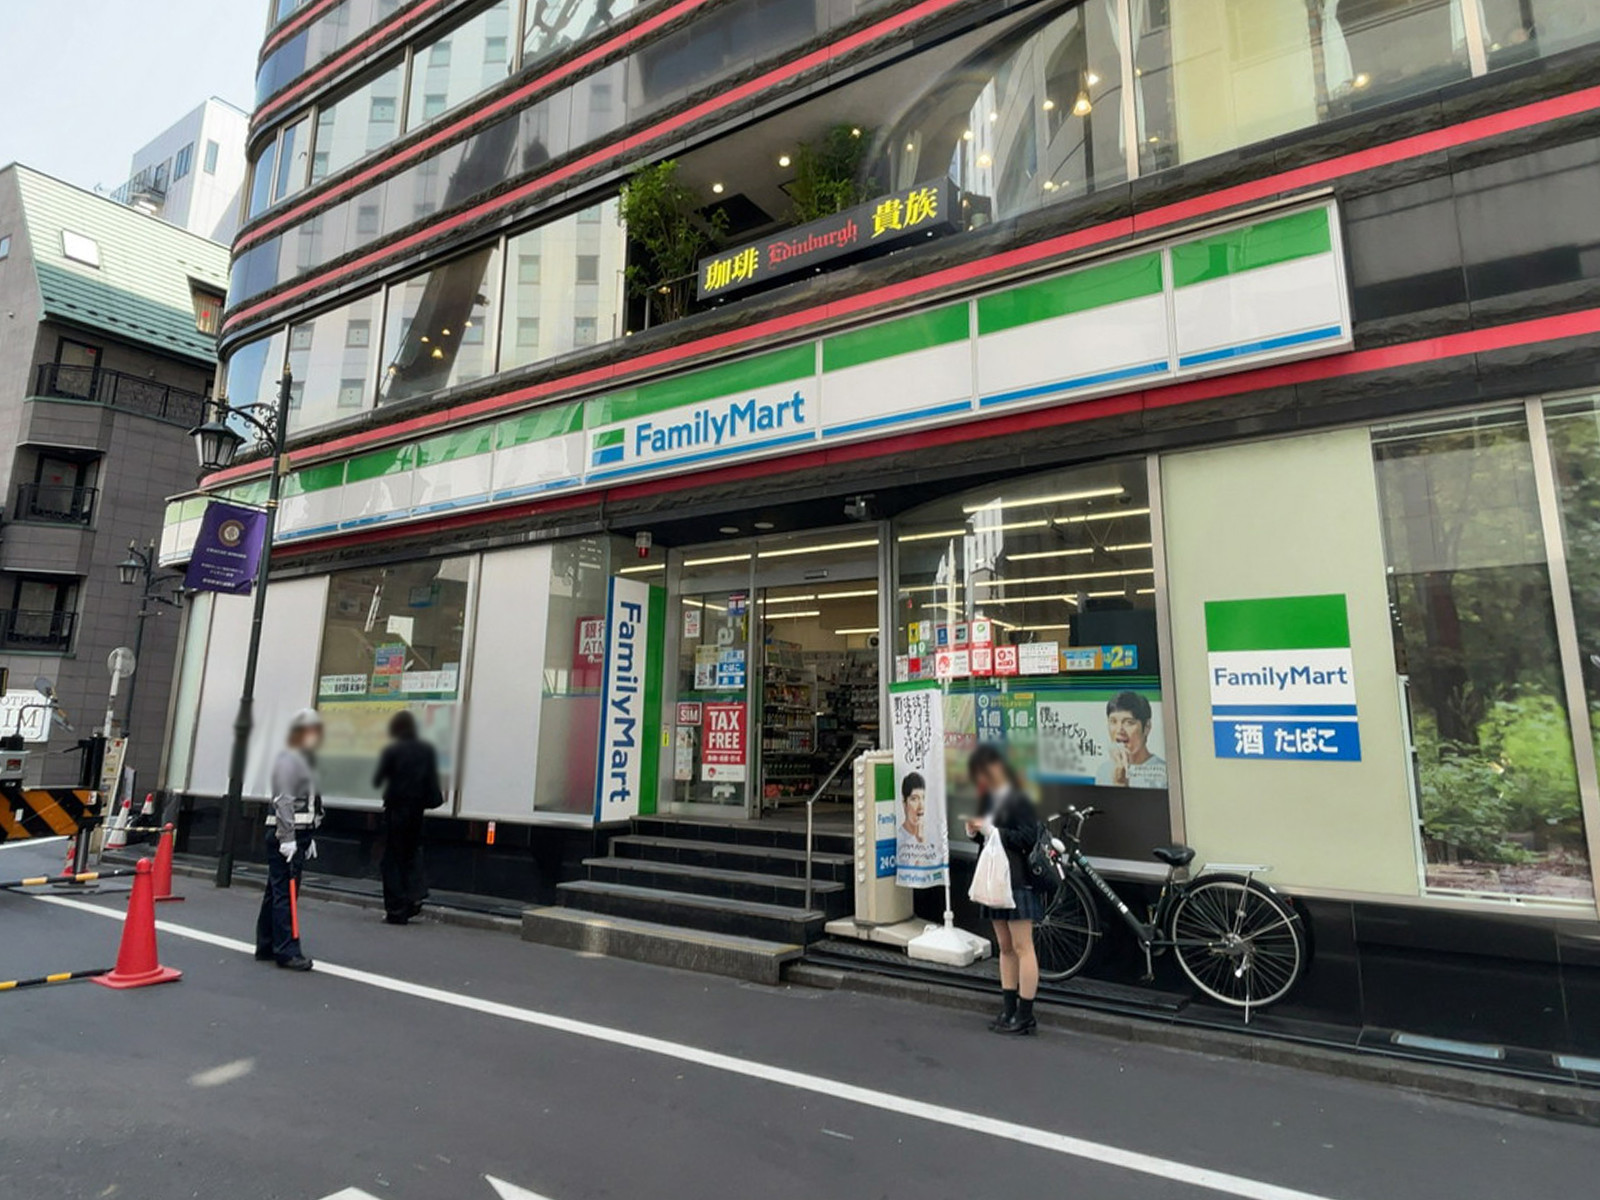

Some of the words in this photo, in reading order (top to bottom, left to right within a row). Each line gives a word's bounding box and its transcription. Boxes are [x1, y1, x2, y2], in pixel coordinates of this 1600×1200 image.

[704, 247, 759, 292] 珈琲
[767, 218, 858, 268] Edinburgh
[871, 187, 939, 239] 貴族
[636, 391, 805, 456] FamilyMart
[1214, 666, 1348, 691] FamilyMart
[610, 601, 642, 803] FamilyMart
[680, 710, 698, 722] SIM
[709, 711, 740, 731] TAX
[708, 732, 740, 749] FREE
[1234, 724, 1264, 754] 酒
[1274, 727, 1338, 753] たばこ
